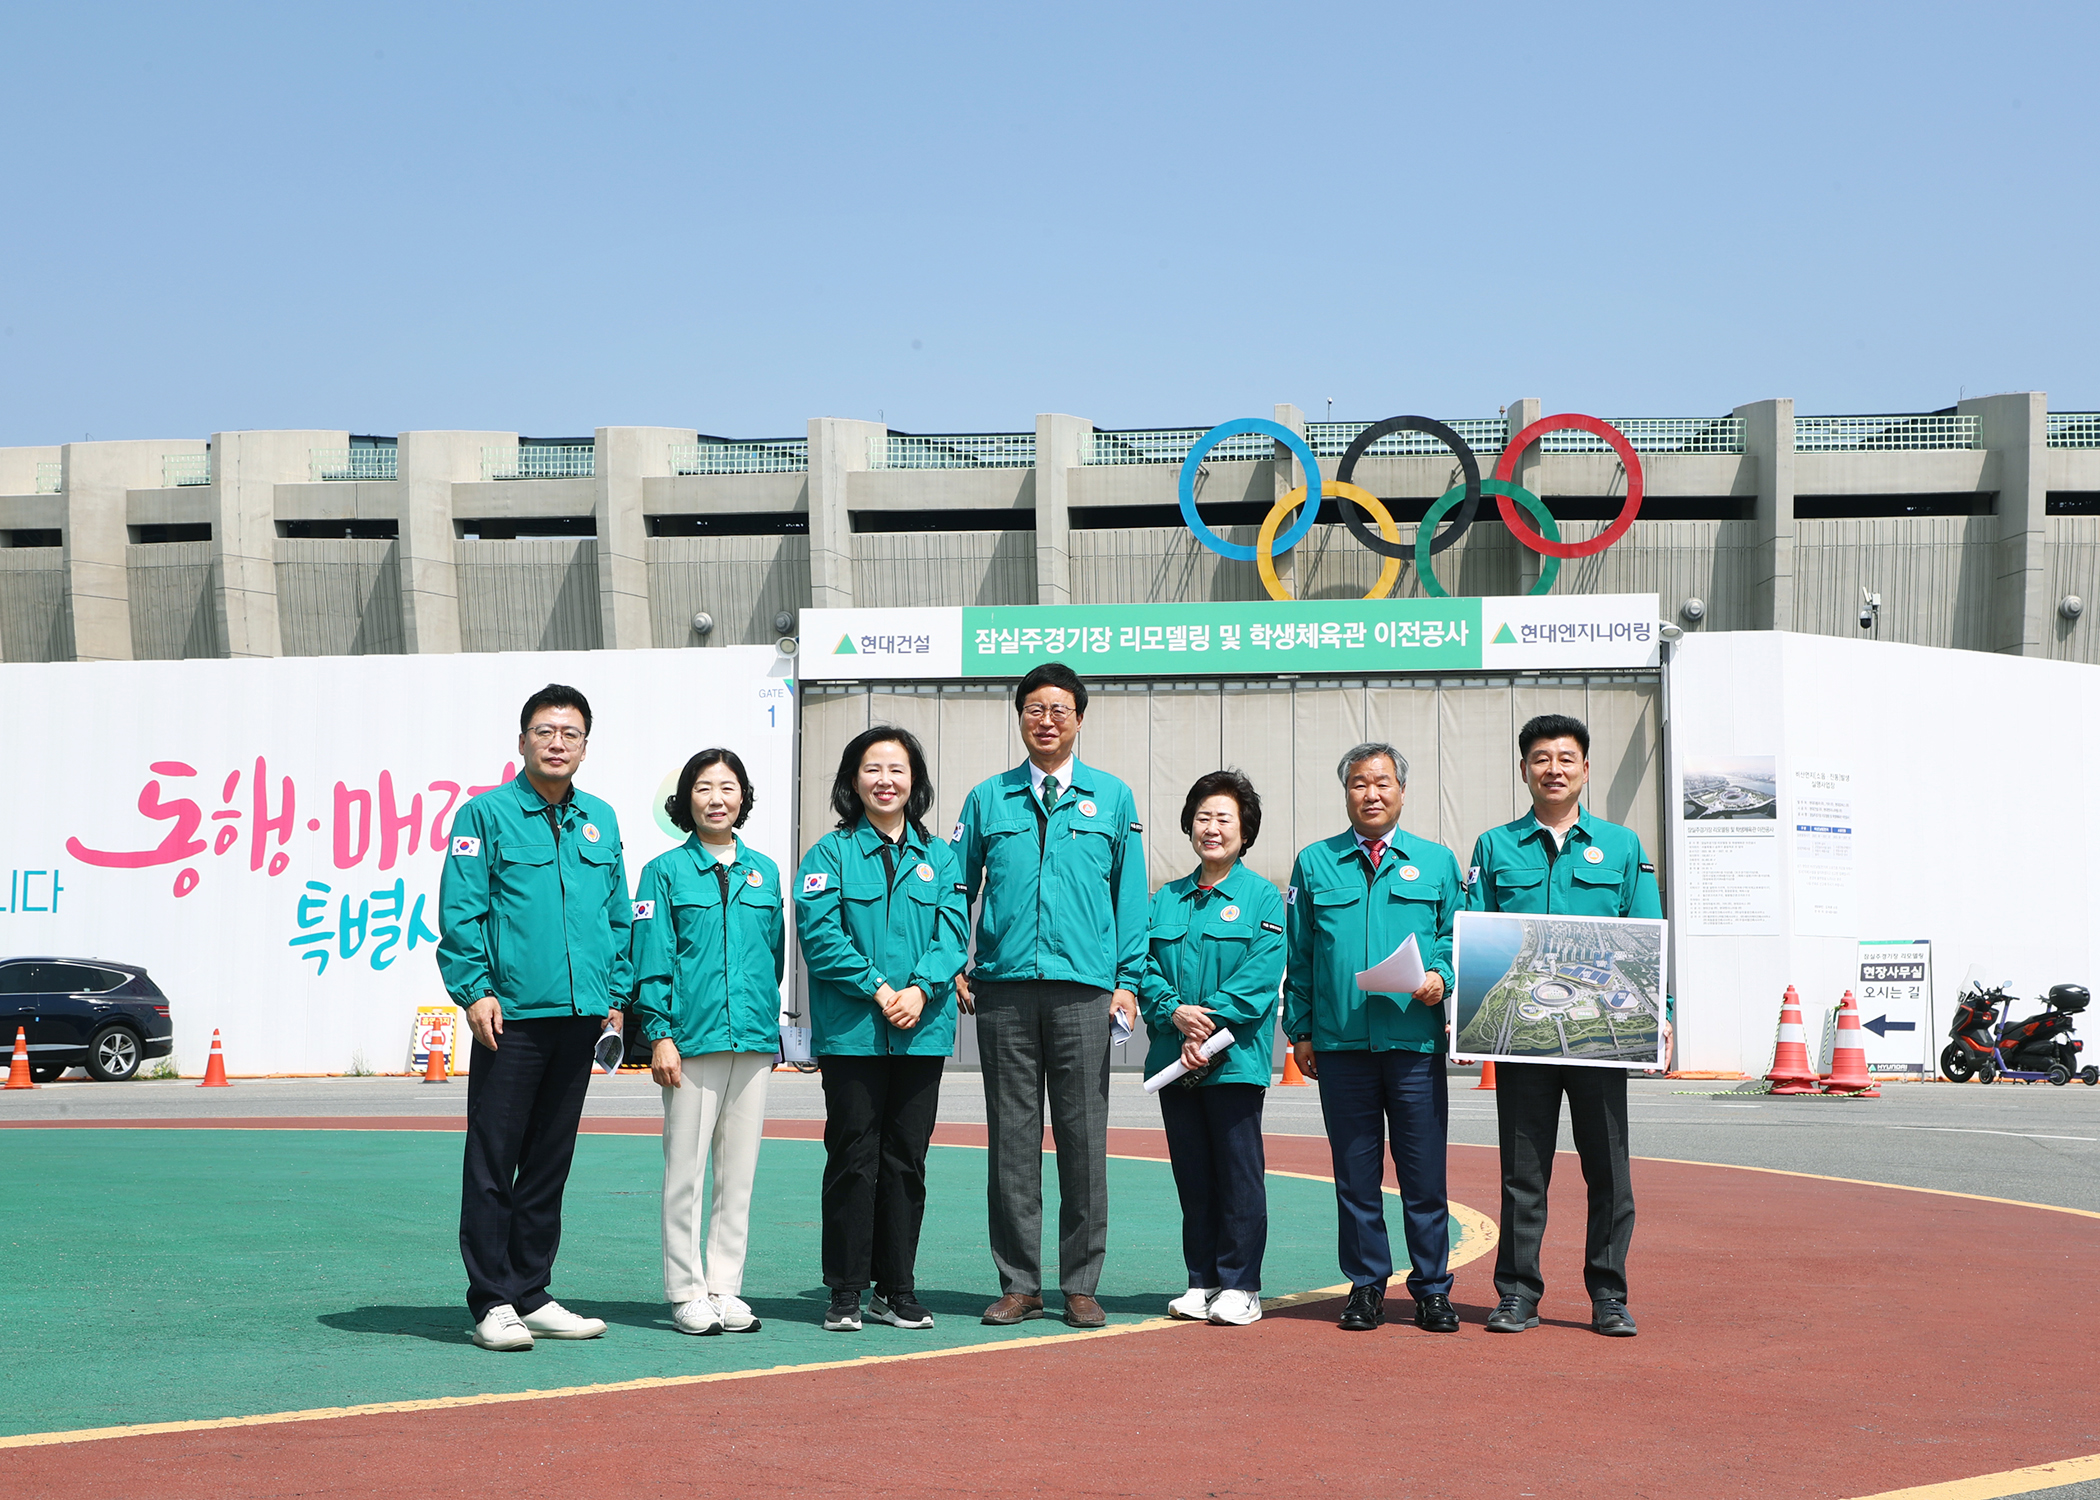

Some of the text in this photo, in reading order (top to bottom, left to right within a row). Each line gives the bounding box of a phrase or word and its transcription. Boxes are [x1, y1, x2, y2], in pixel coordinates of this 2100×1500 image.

[974, 619, 1469, 655] 잠실주경기장 리모델링 및 학생체육관 이전공사
[1520, 621, 1651, 644] 현대엔지니어링
[861, 633, 931, 655] 현대건설
[758, 688, 785, 699] GATE
[767, 704, 776, 728] 1
[1863, 965, 1923, 980] 현장사무실
[1863, 986, 1920, 999] 오시는 길
[421, 1017, 450, 1026] 흡연지
